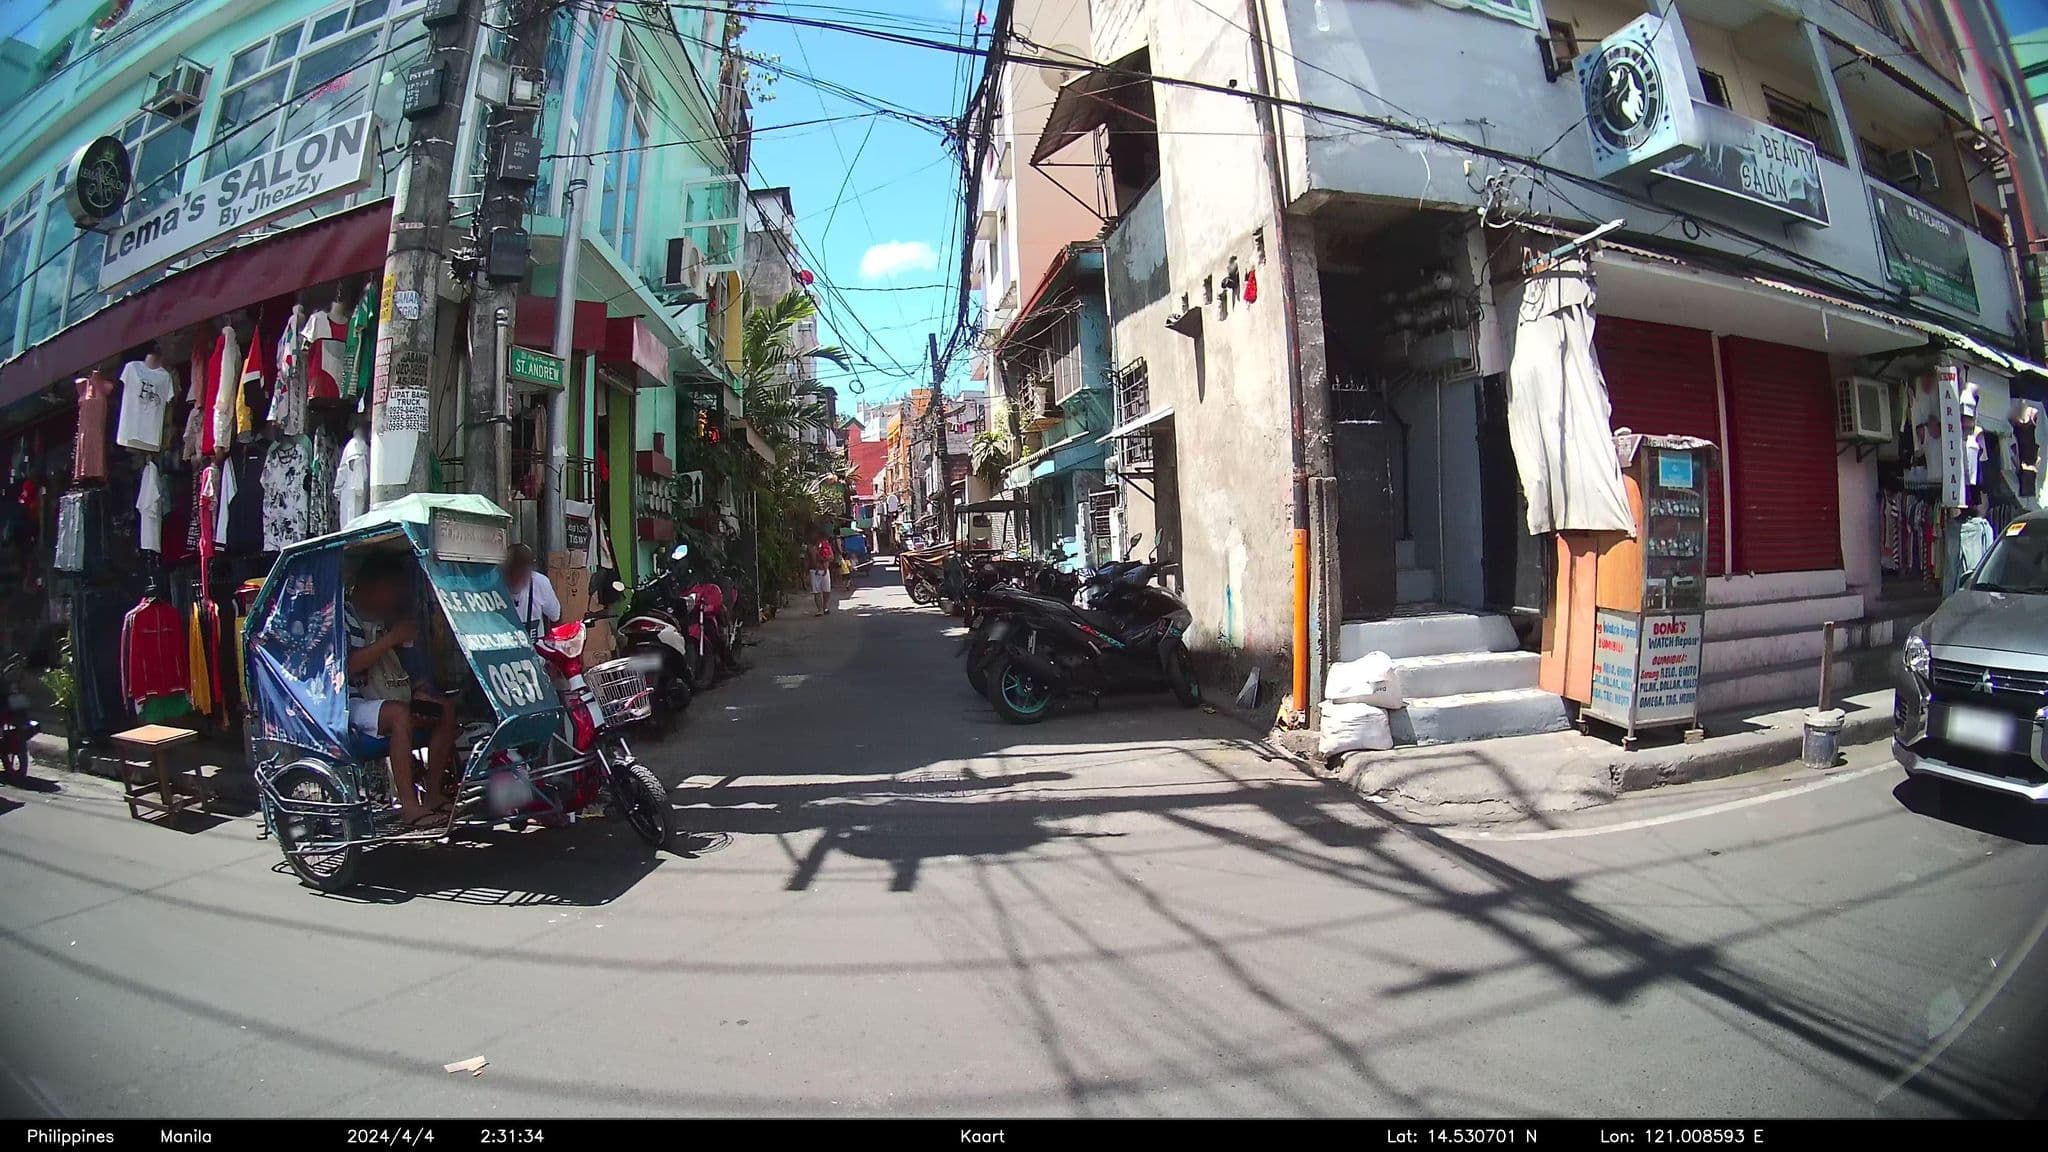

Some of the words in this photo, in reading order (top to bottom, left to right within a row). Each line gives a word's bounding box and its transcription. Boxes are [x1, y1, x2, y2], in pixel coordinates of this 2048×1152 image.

[1760, 135, 1816, 174] BEAUTY
[103, 192, 207, 267] Lema's
[218, 117, 367, 207] SALON
[1742, 164, 1789, 201] SALON
[219, 203, 242, 227] By
[247, 172, 323, 214] JhezZy
[515, 358, 527, 374] ST.
[528, 362, 560, 381] ANDREW
[390, 391, 409, 399] LIPAT
[1945, 389, 1957, 501] ARRIVAL
[464, 590, 508, 612] PODA
[1648, 637, 1674, 649] WATCH
[1675, 636, 1699, 648] Repair
[1653, 621, 1686, 635] BONG'S
